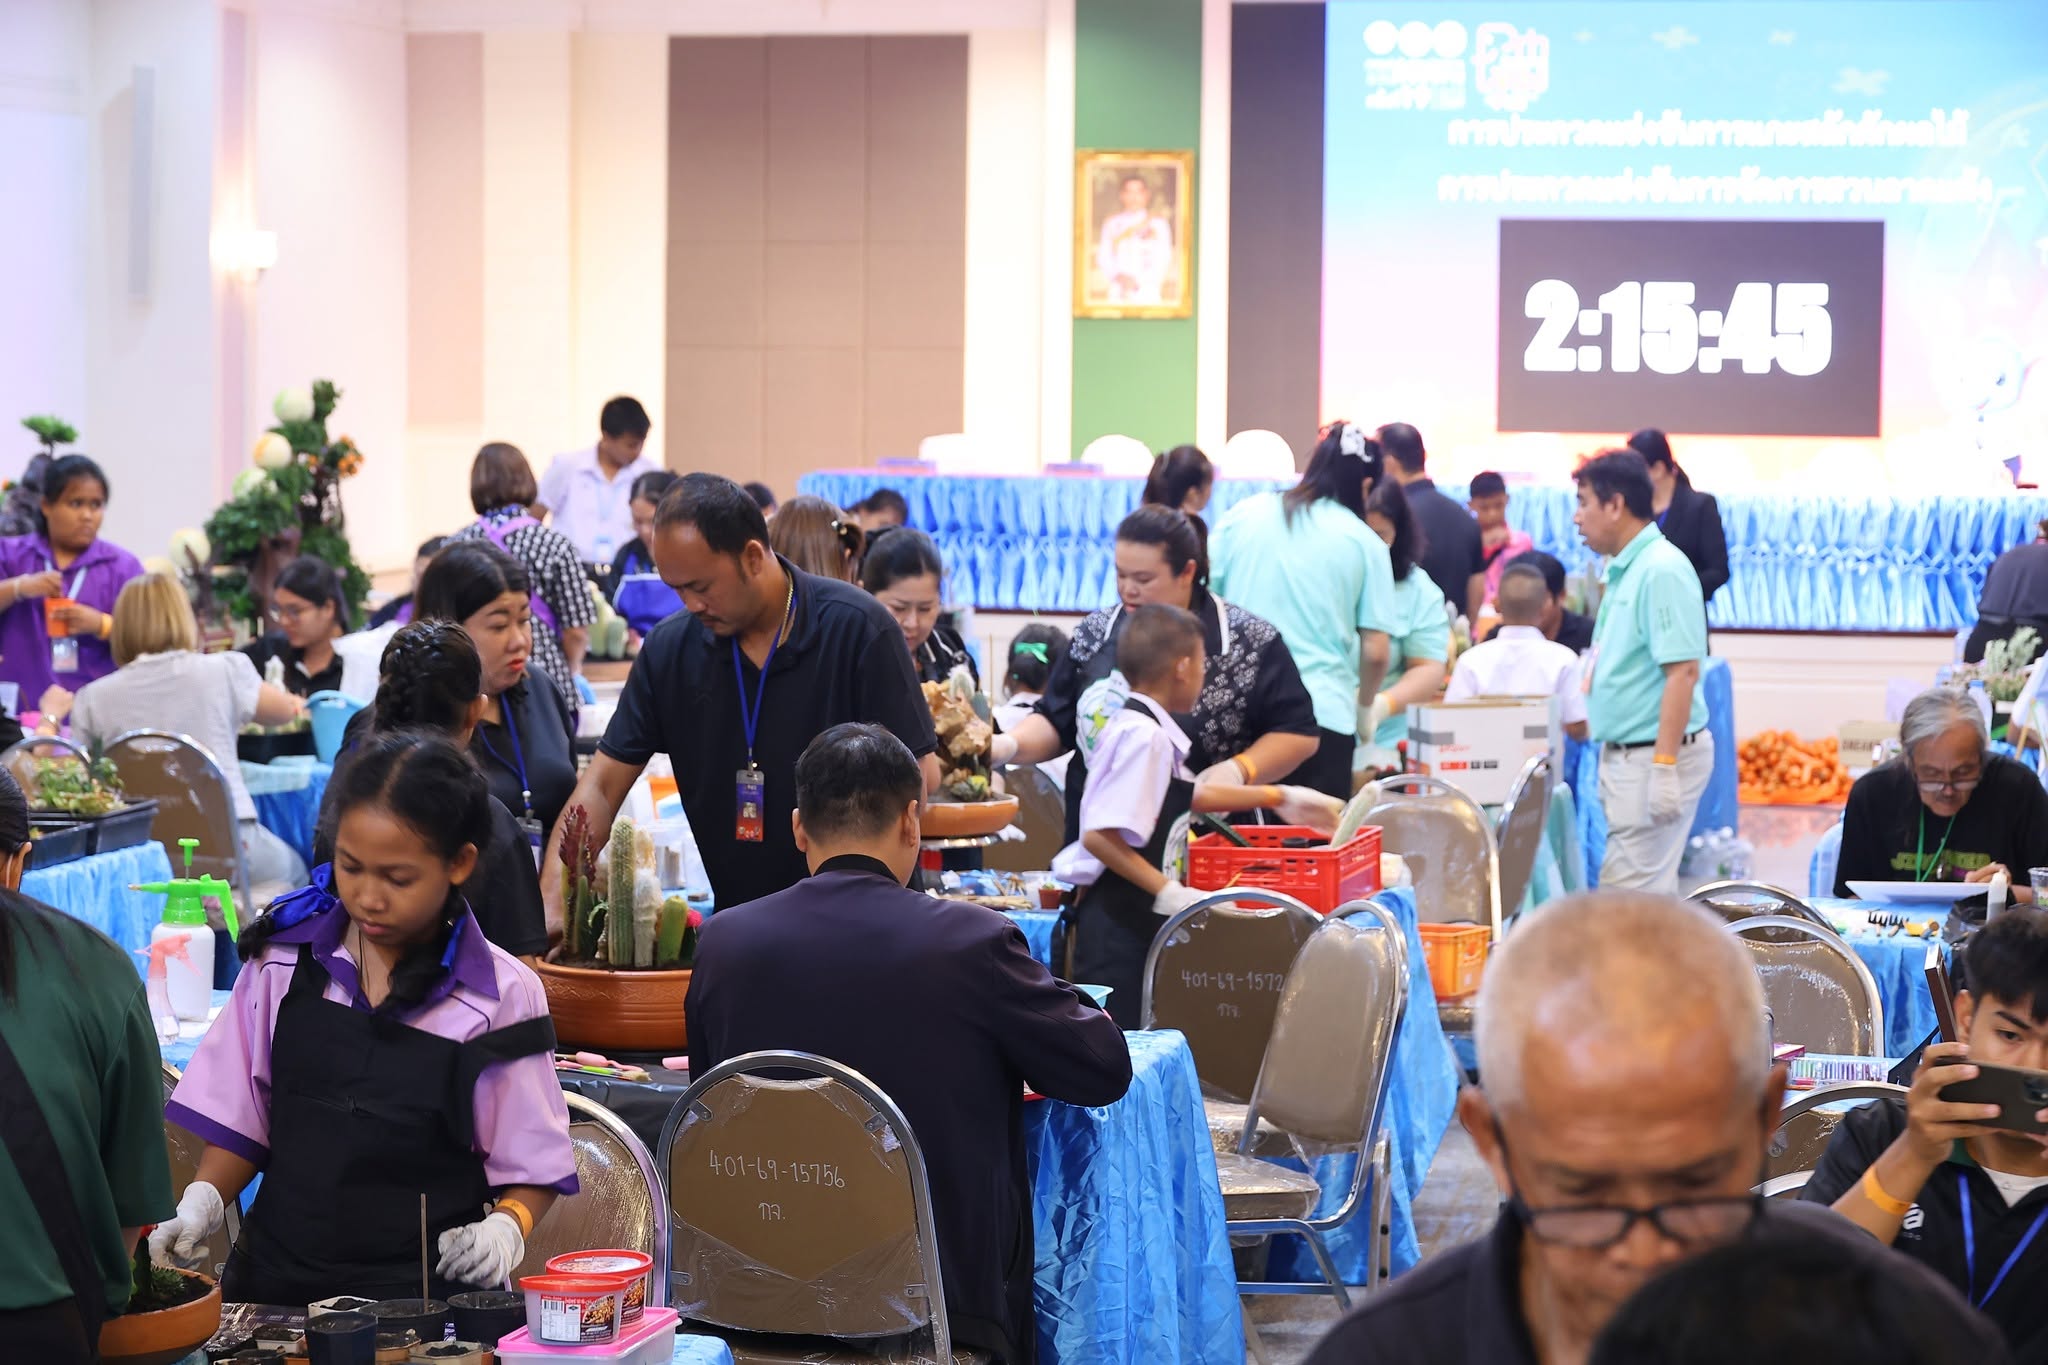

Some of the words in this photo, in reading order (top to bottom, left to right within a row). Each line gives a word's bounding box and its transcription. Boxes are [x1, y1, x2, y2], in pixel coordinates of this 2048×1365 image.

[1523, 279, 1832, 376] 2:15:45
[1181, 969, 1286, 993] 401-69-1572
[709, 1149, 846, 1188] 401-69-15756
